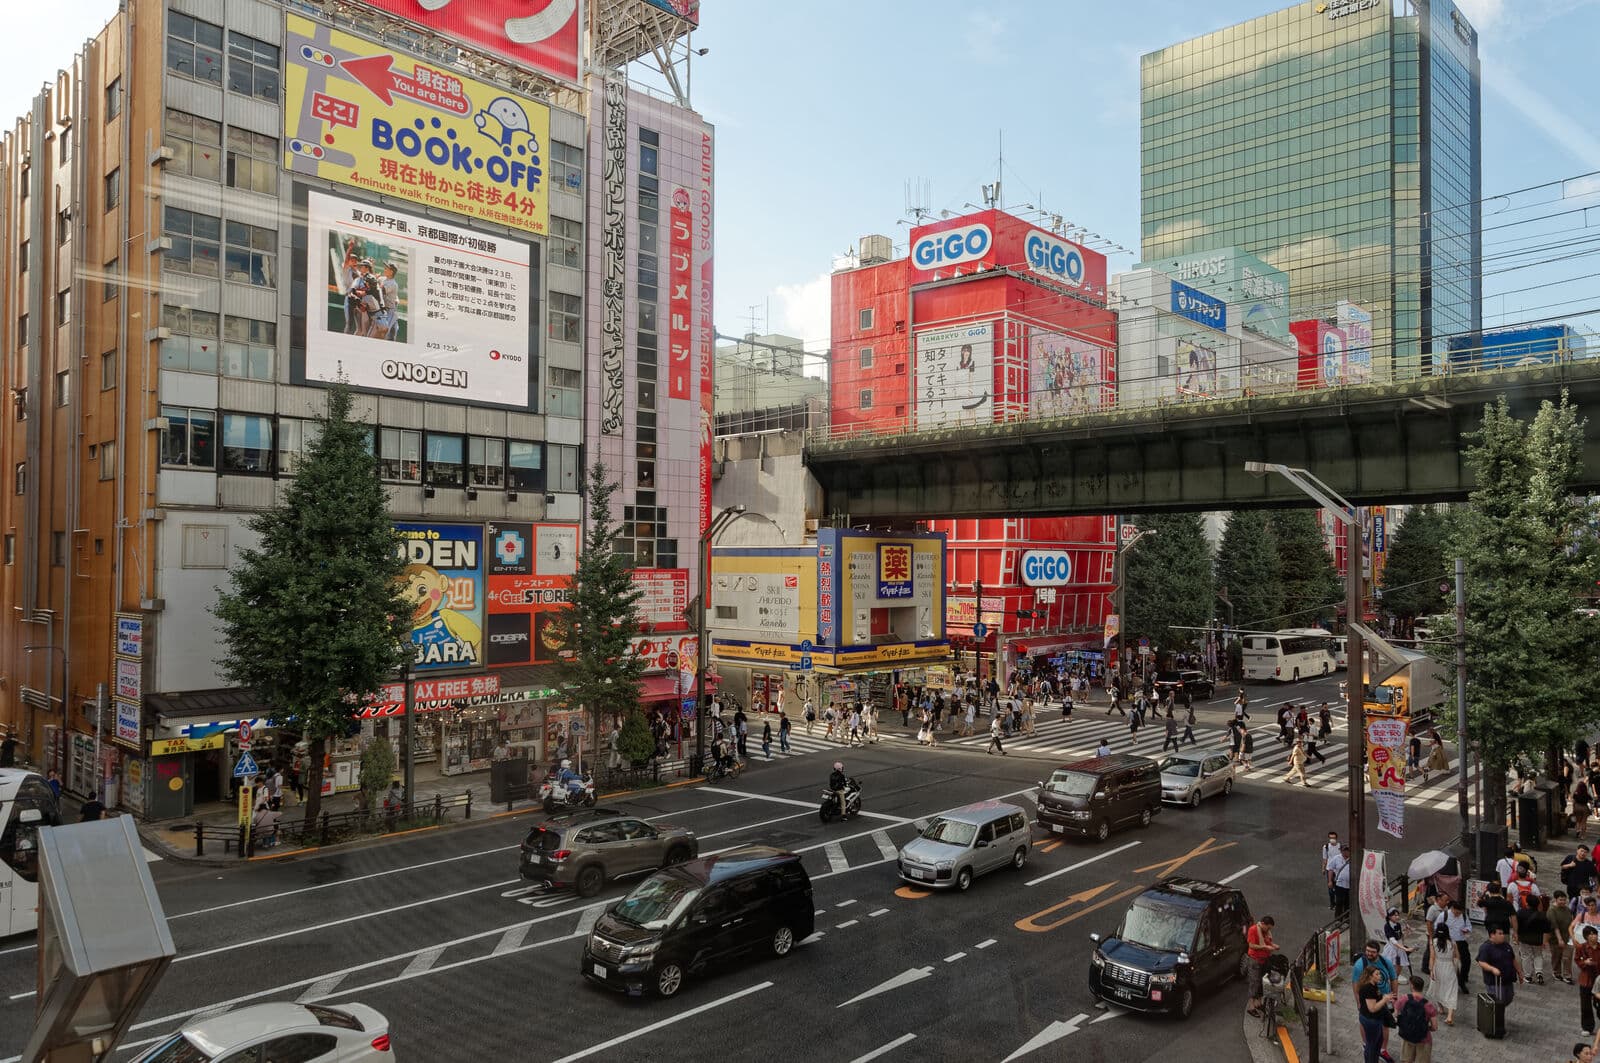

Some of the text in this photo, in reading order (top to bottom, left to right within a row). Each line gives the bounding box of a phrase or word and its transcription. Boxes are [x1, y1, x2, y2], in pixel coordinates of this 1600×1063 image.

[392, 76, 465, 110] You are here
[416, 68, 461, 97] 現在地
[379, 156, 536, 218] 現在地から徒歩4分
[399, 186, 423, 201] walk
[425, 192, 450, 208] from
[452, 198, 474, 213] here
[701, 132, 712, 251] ADULT GOODS
[351, 207, 497, 255] 夏の甲子園、京都国際が初優勝
[916, 228, 988, 266] GiGO
[1028, 235, 1082, 281] GiGO
[1178, 255, 1226, 281] HIROSE
[672, 221, 690, 392] ラブメルシー
[700, 279, 712, 382] LOVE MERCI
[382, 359, 468, 389] ONODEN
[924, 350, 936, 411] 知ってる?
[427, 529, 440, 540] to
[885, 547, 908, 580] 薬
[1026, 556, 1069, 581] GiGO
[1035, 588, 1057, 604] 1号館
[760, 618, 787, 628] Kanebo
[438, 680, 469, 697] FREE
[471, 677, 499, 695] 免税
